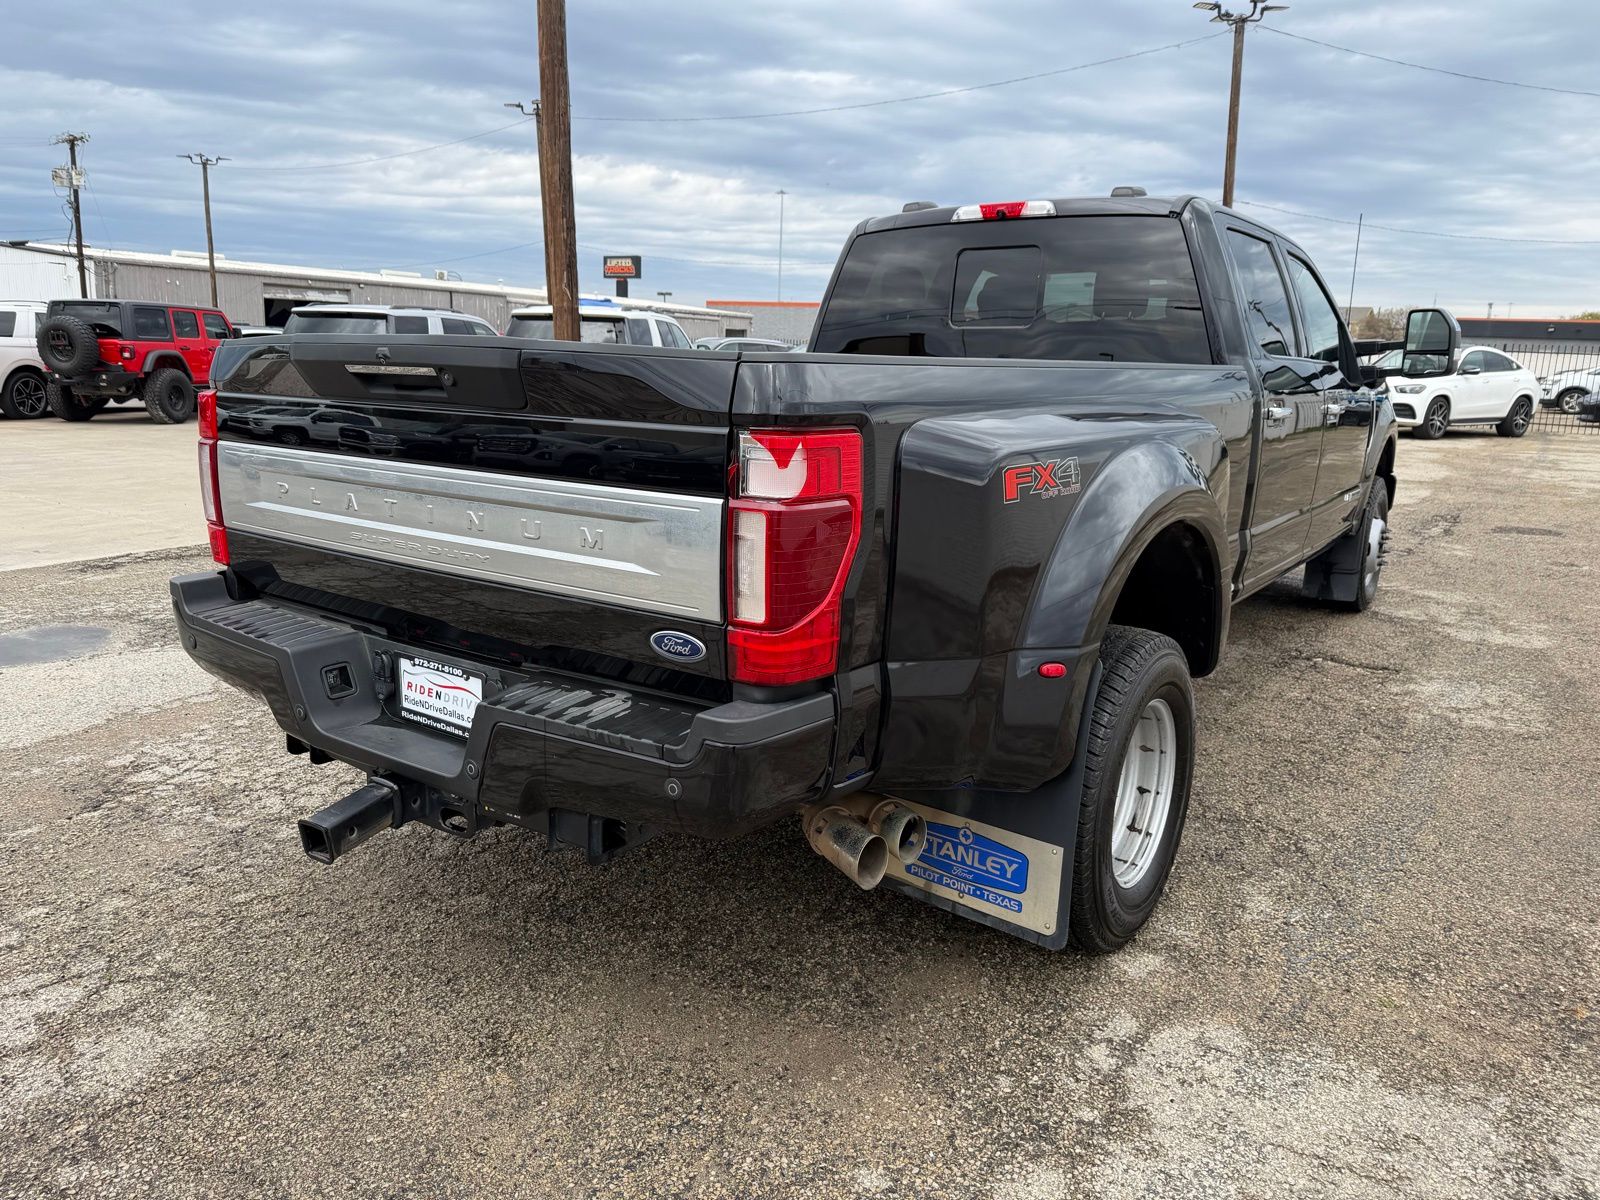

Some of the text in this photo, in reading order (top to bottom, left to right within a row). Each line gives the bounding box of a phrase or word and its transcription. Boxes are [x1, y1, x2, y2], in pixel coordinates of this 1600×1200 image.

[1003, 456, 1080, 504] FX4
[276, 481, 604, 550] PLATINUM
[351, 531, 490, 563] SUPER DUTY
[661, 636, 692, 655] Ford
[414, 658, 463, 677] 972-271-5100
[923, 834, 1019, 879] TANLEY
[951, 866, 974, 881] Ford
[910, 865, 1019, 911] PILOT POINT TEXAS
